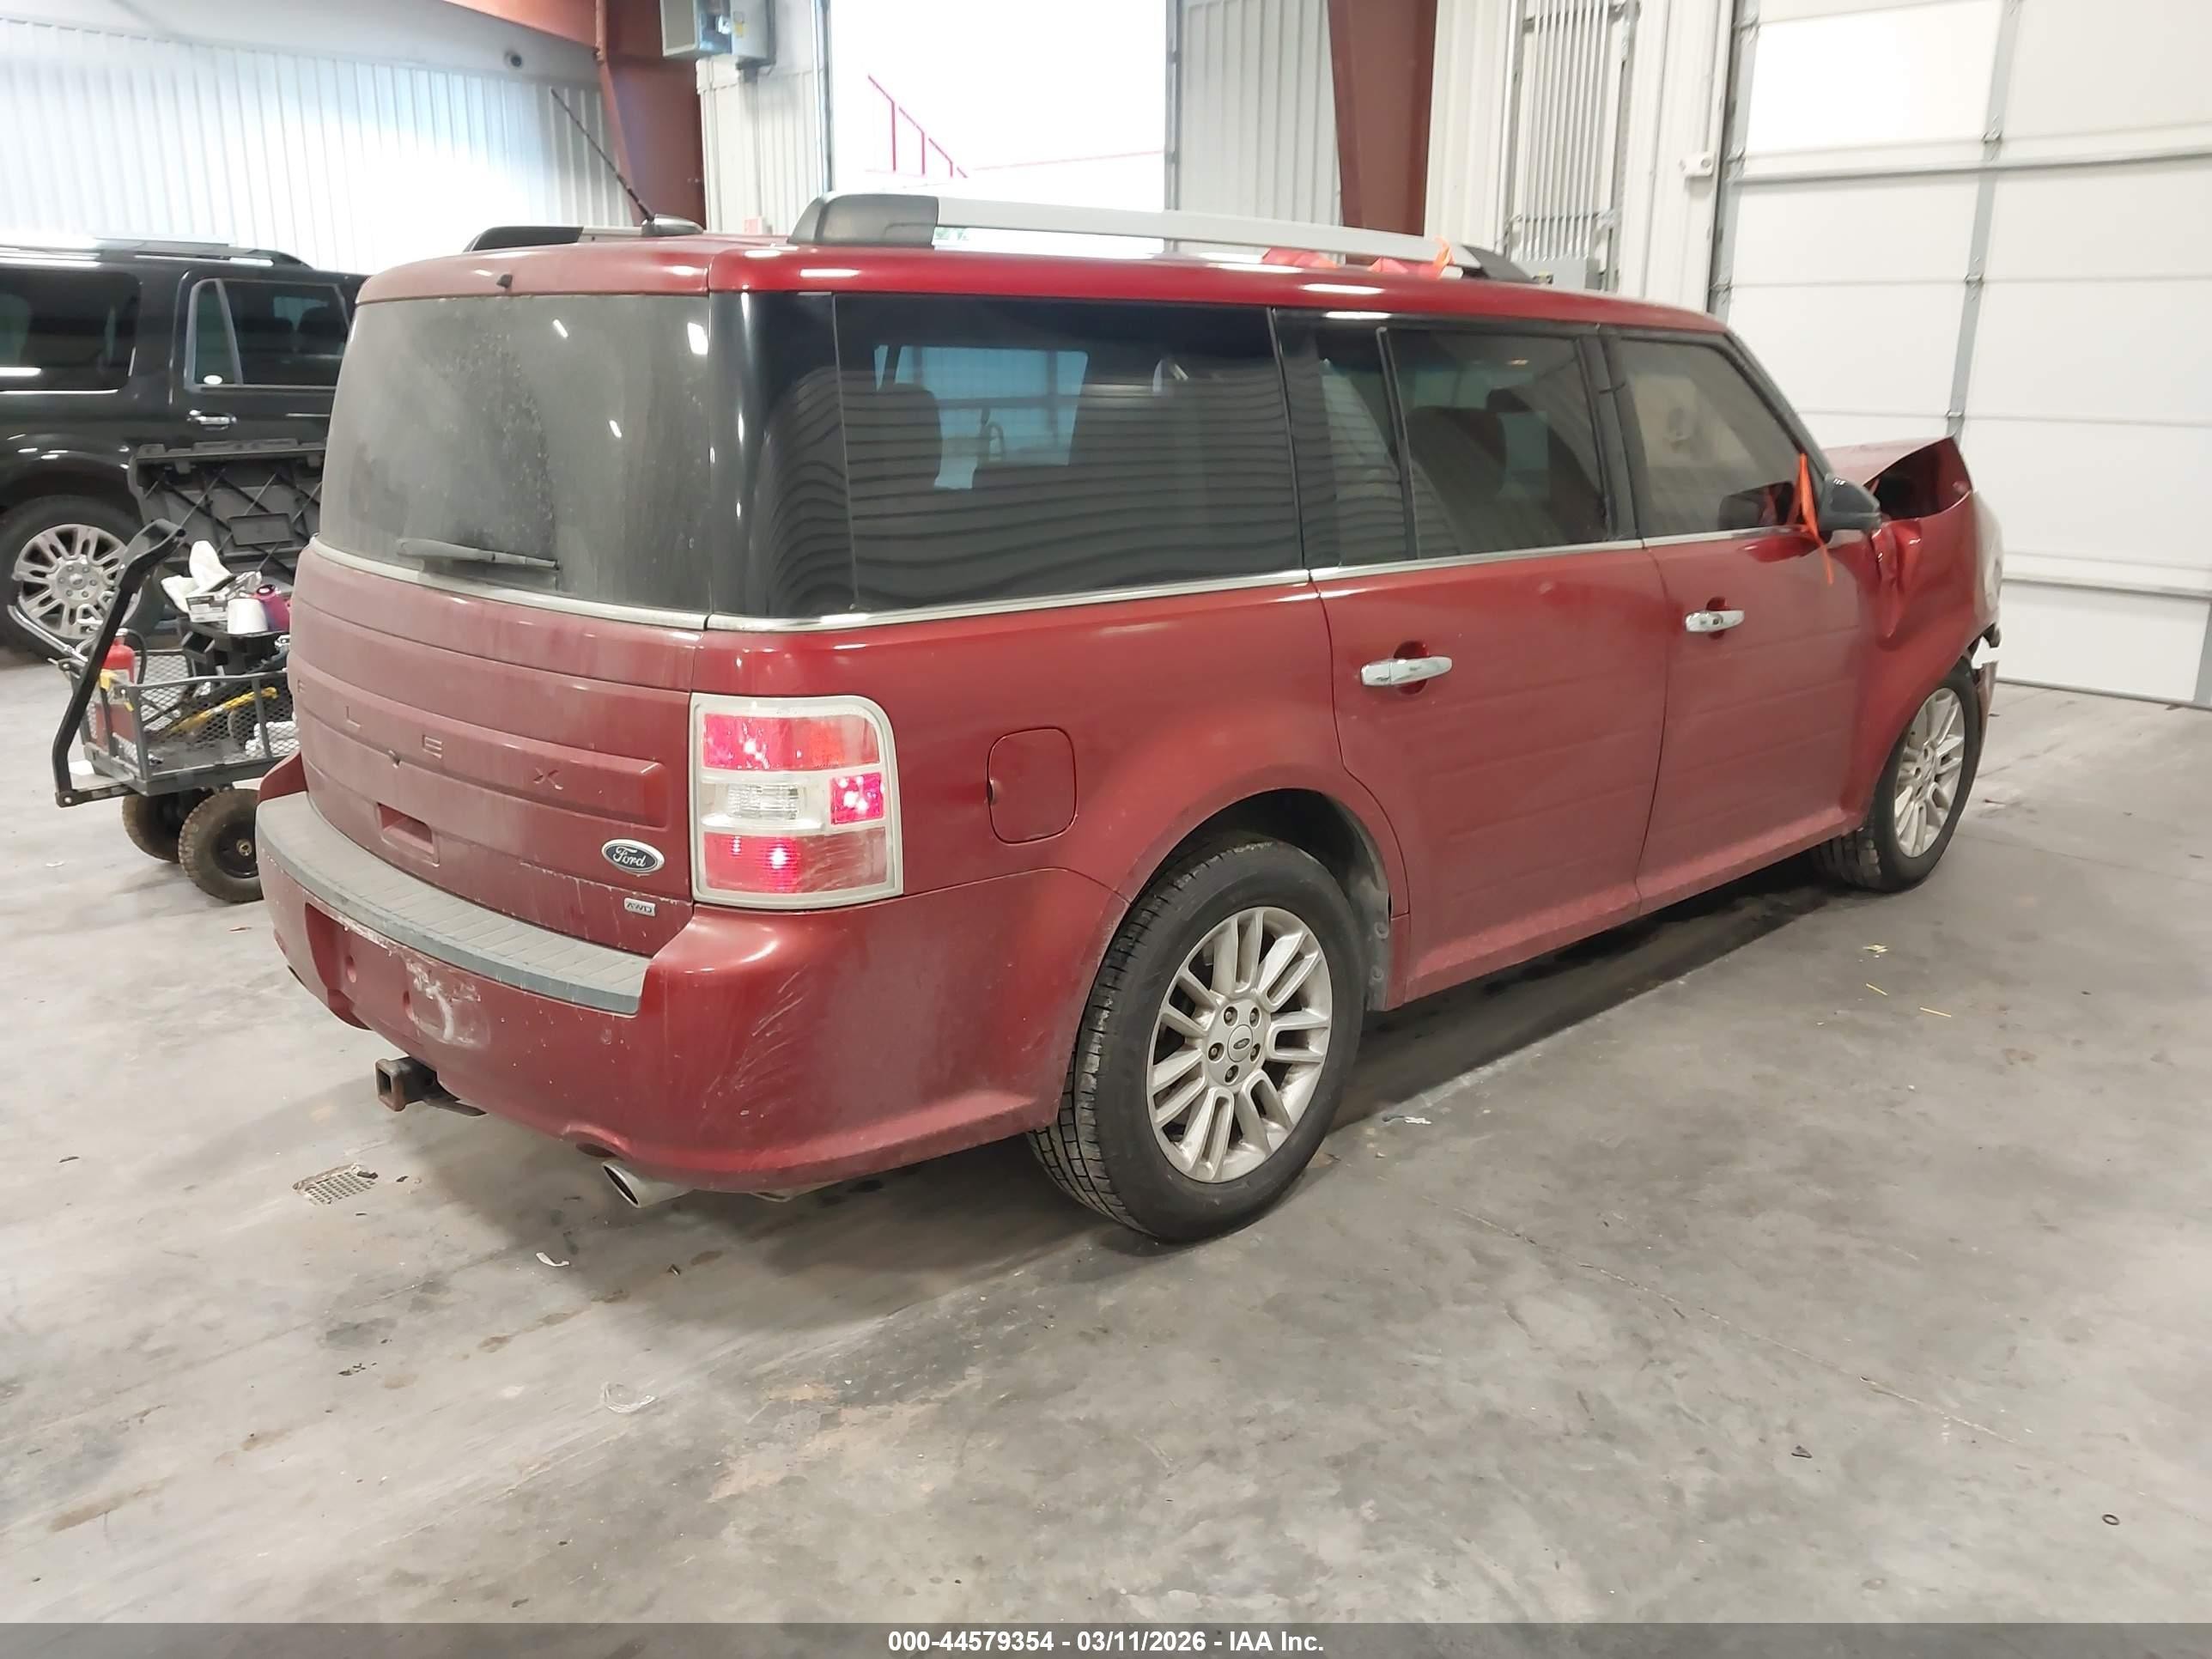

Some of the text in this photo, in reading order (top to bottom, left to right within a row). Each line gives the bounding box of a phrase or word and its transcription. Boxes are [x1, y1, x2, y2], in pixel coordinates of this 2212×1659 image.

[297, 679, 563, 791] FLEX
[612, 846, 647, 867] Ford
[626, 902, 653, 914] AWD
